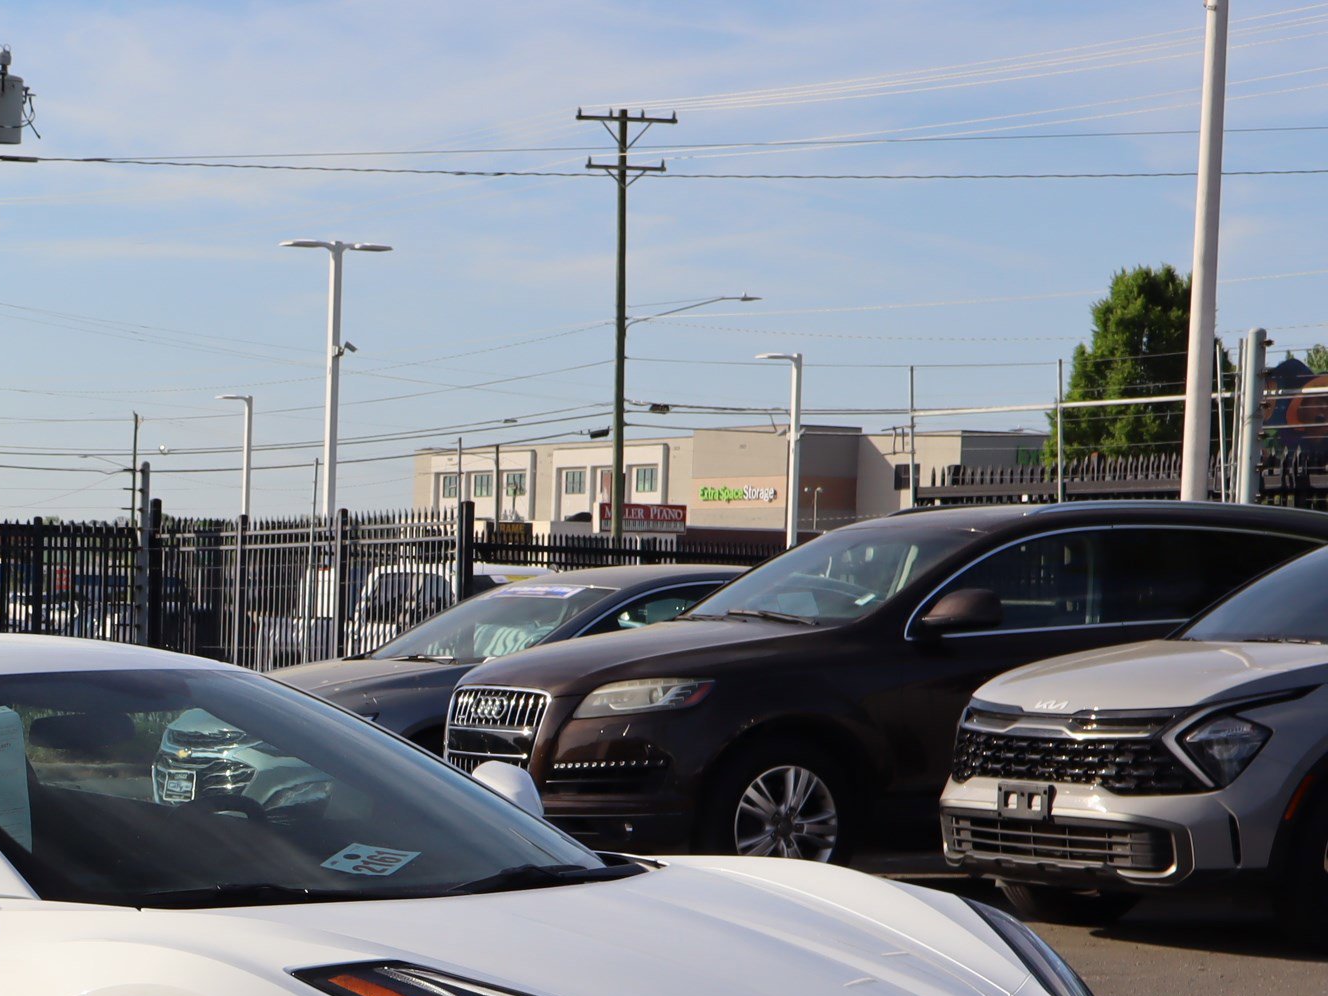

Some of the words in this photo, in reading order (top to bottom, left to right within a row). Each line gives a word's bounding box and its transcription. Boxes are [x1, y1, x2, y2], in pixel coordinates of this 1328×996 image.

[604, 505, 645, 519] MLER
[649, 505, 683, 520] PIANO
[353, 850, 410, 873] 2161
